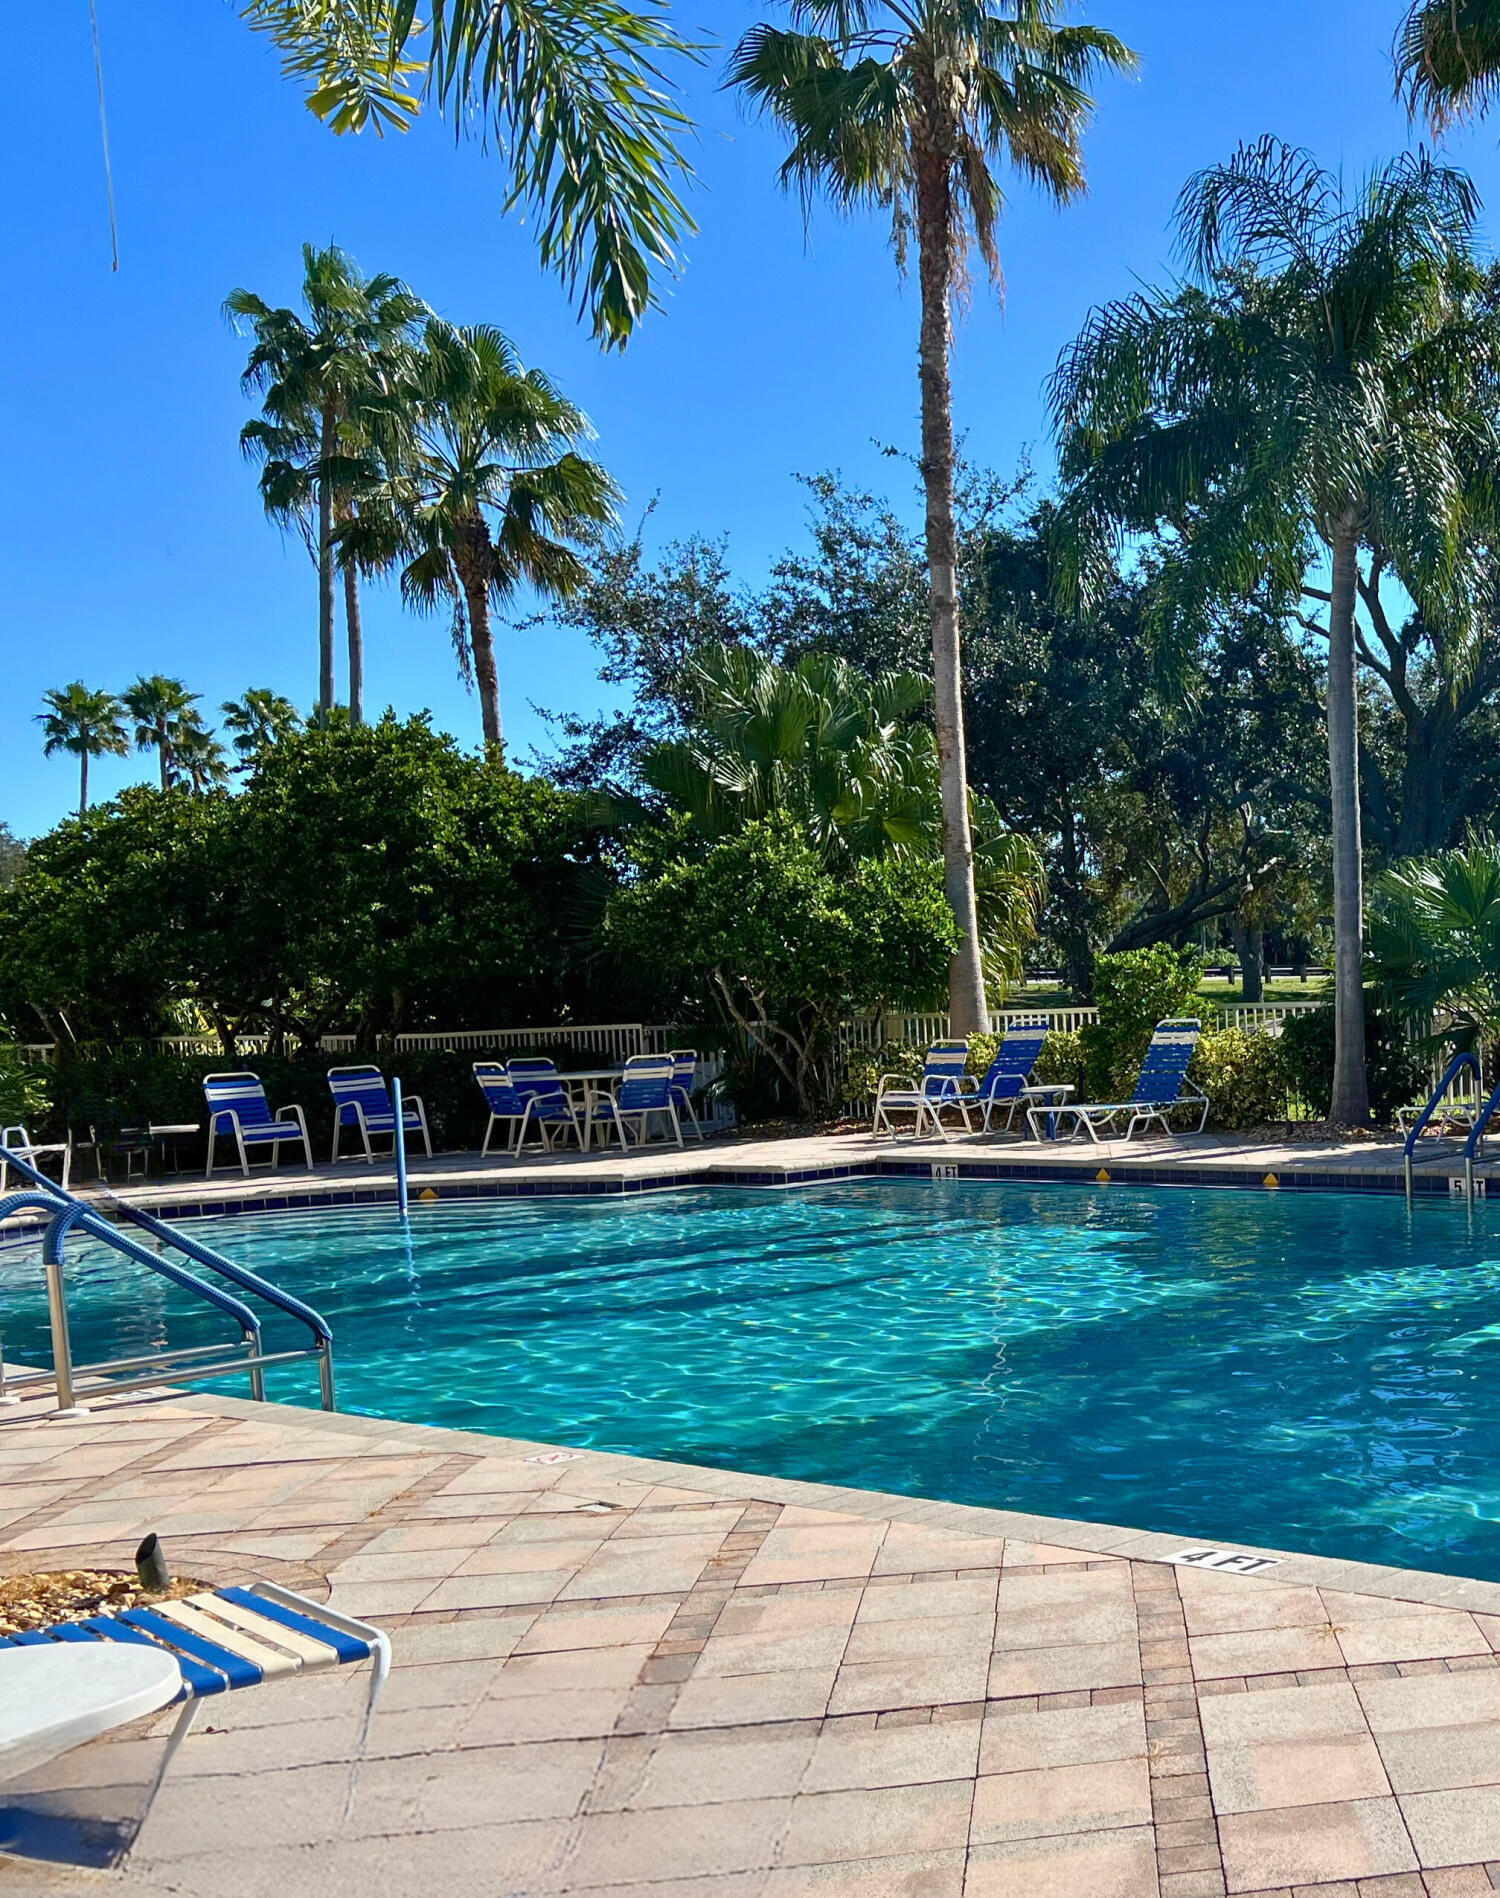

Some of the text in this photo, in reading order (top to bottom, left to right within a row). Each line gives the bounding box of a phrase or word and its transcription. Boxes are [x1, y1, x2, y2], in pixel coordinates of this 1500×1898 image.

[935, 1166, 956, 1178] 4 FT
[1454, 1180, 1462, 1192] 5
[1181, 1551, 1278, 1571] 4 FT
